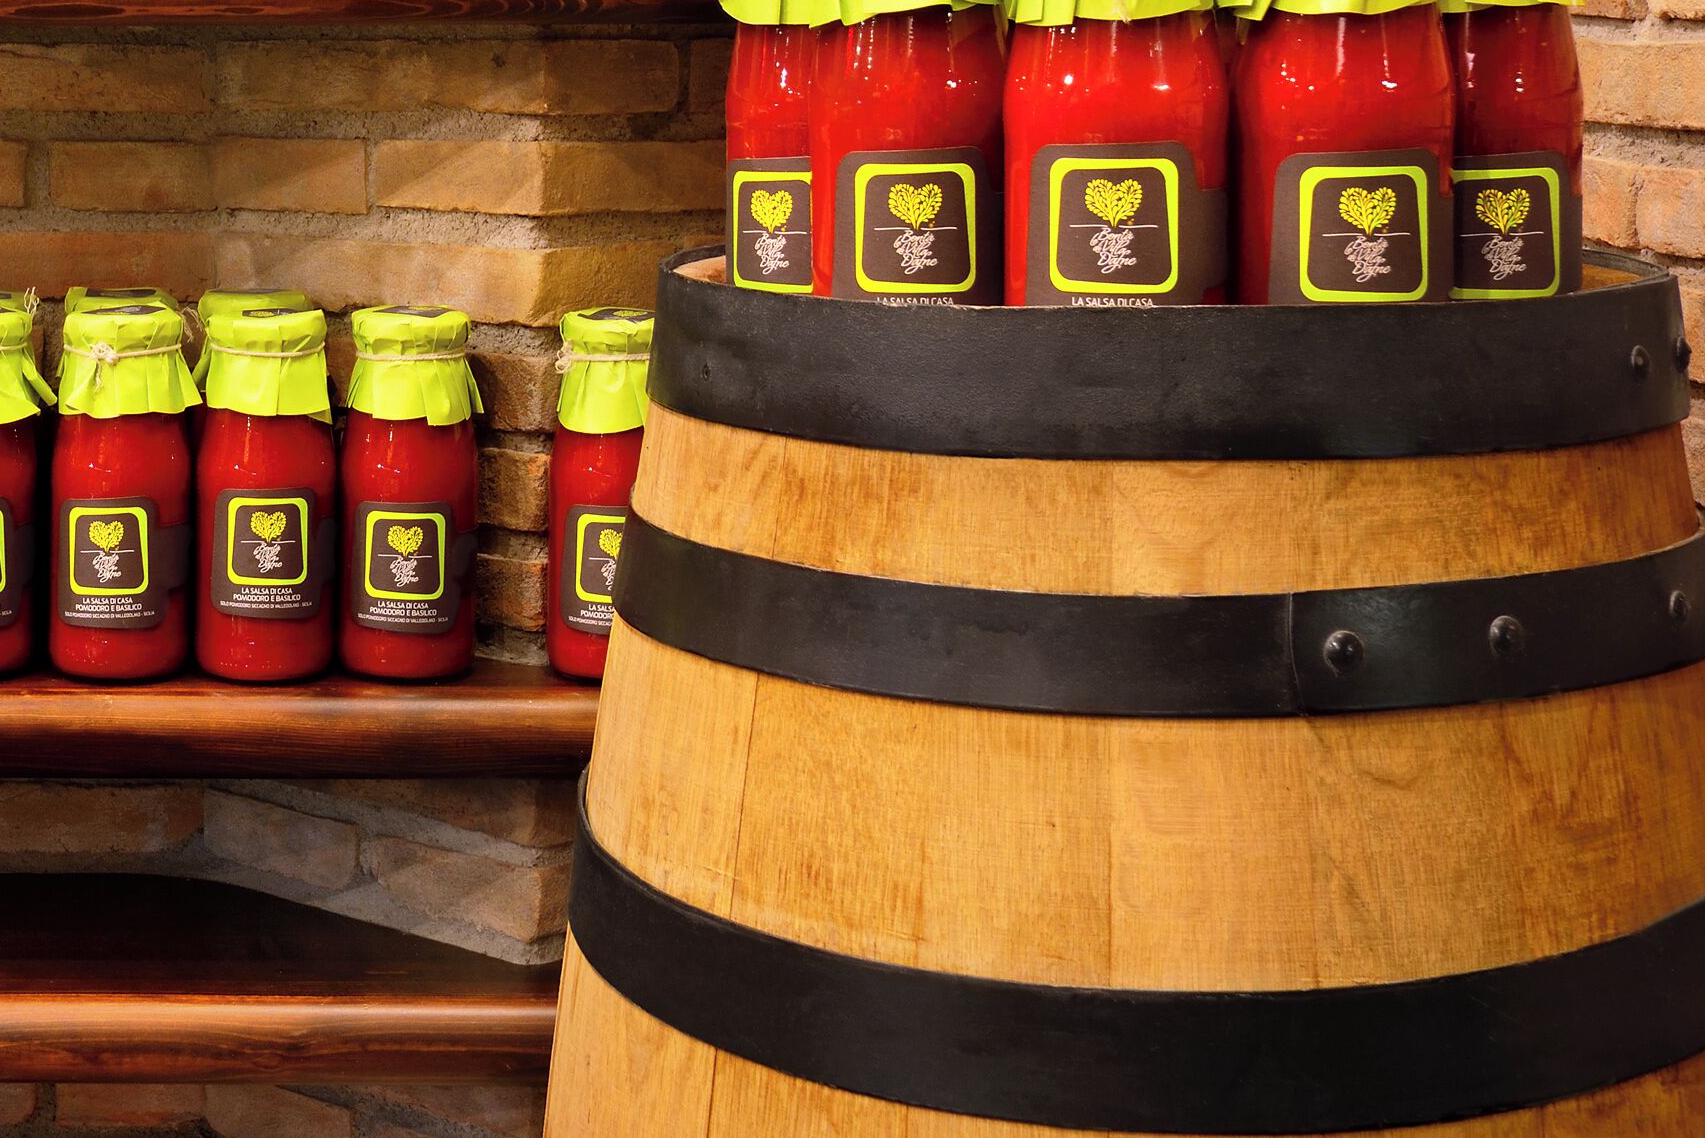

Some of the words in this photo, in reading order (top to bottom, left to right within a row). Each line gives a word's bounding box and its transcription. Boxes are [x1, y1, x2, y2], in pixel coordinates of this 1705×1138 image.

[1071, 297, 1084, 306] LA
[1085, 297, 1115, 307] SALSA
[1117, 298, 1127, 307] DI
[1129, 298, 1153, 307] CASA
[233, 594, 269, 602] POMODORO
[386, 601, 405, 609] SALSA
[369, 607, 405, 616] POMODORO
